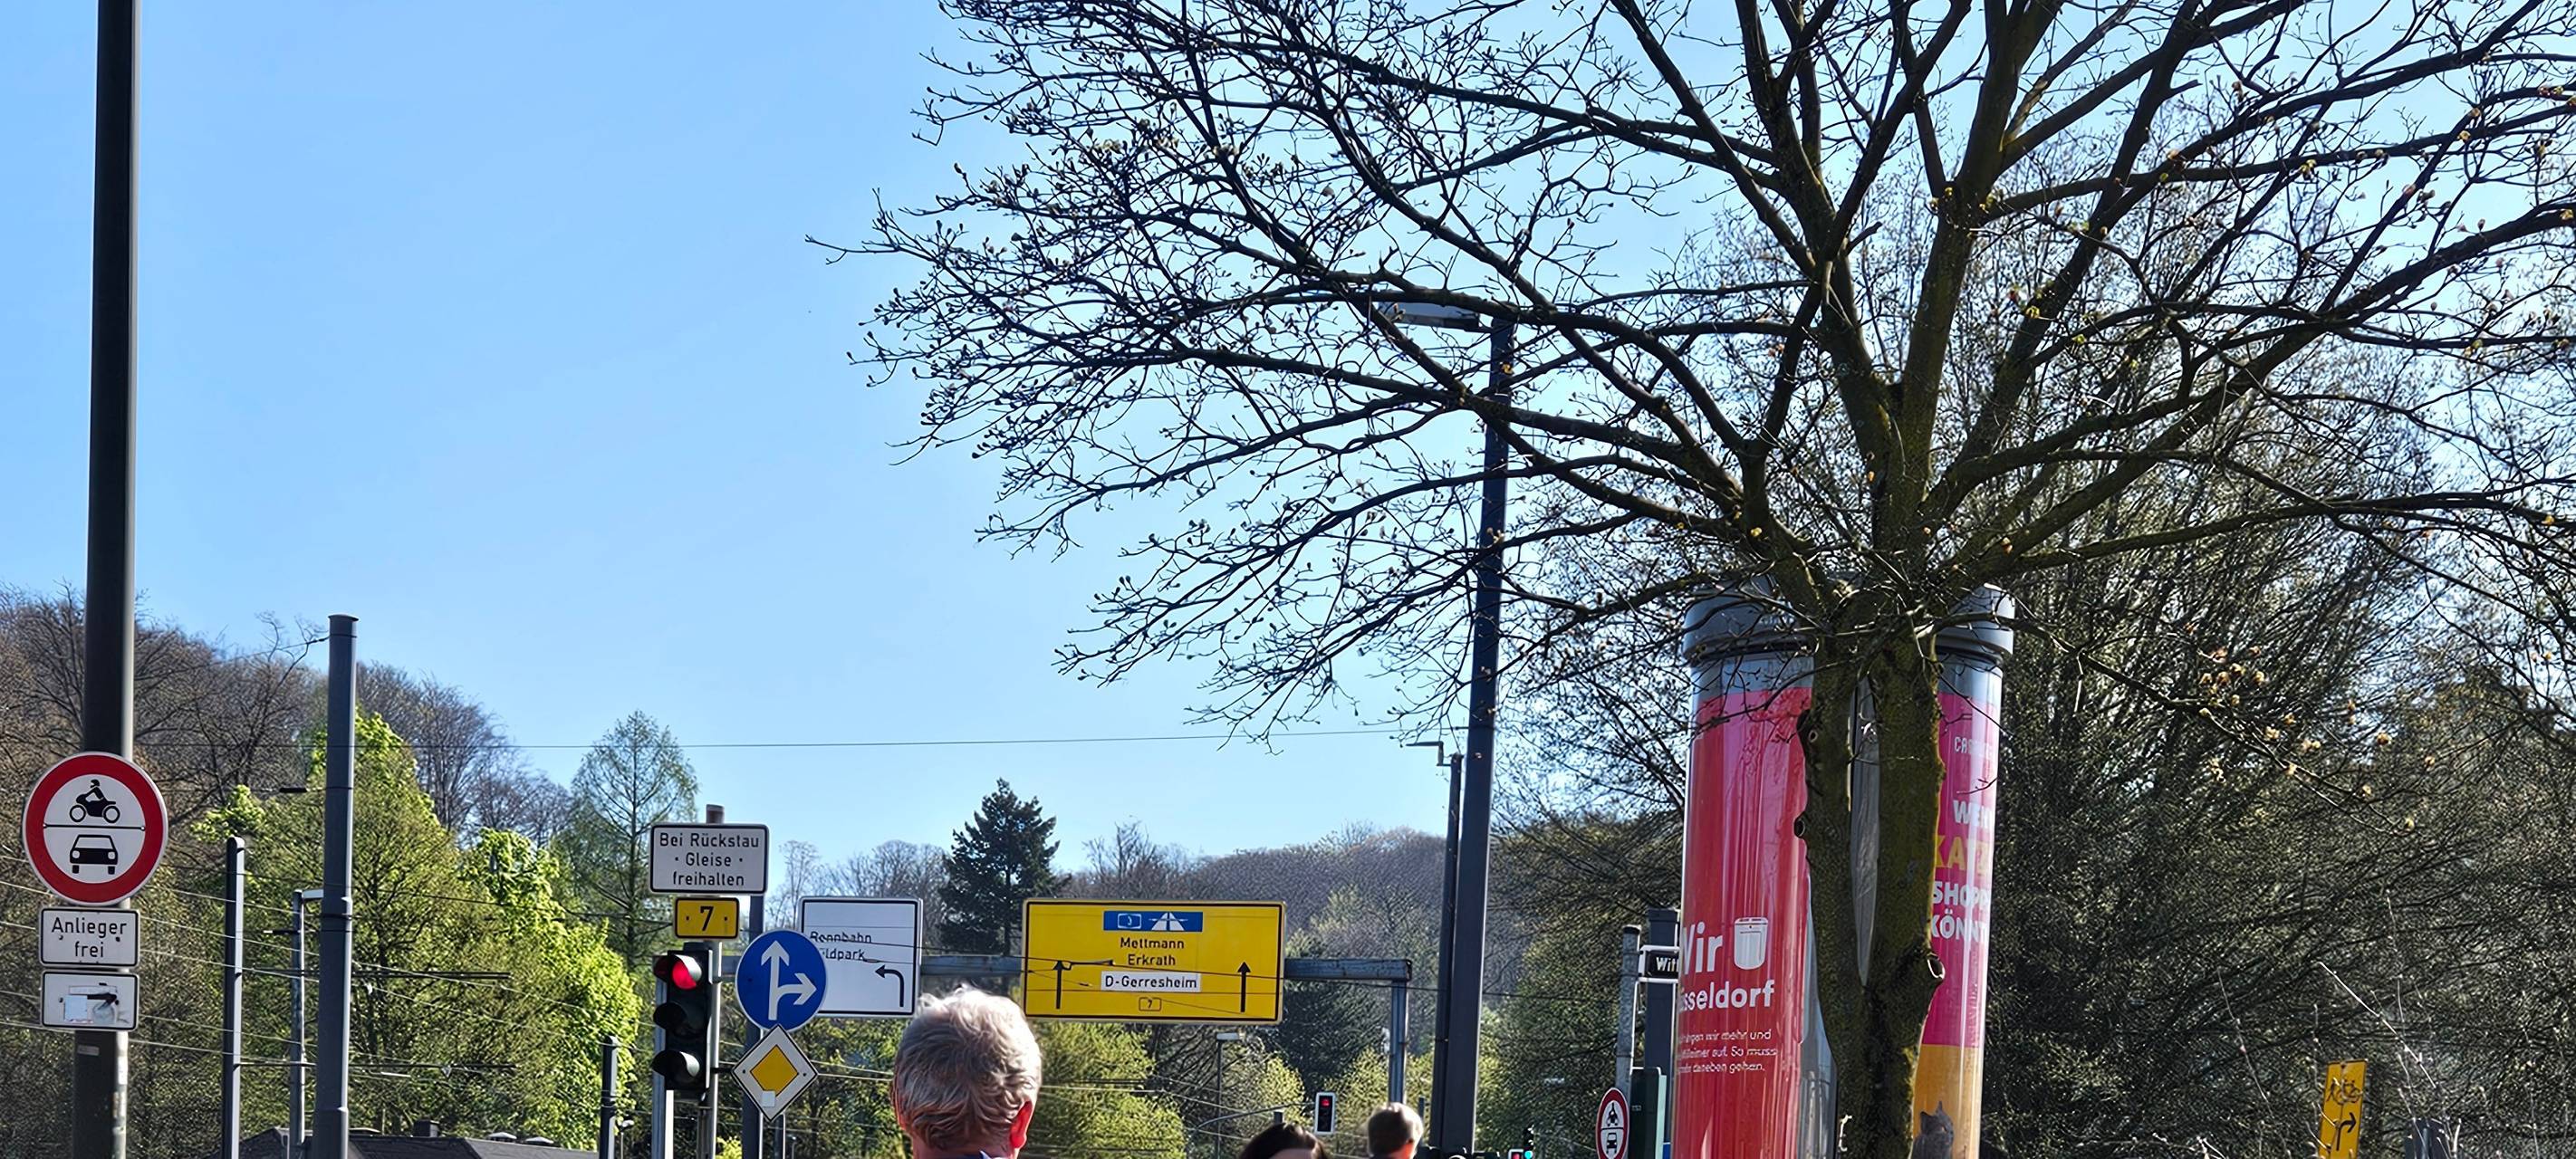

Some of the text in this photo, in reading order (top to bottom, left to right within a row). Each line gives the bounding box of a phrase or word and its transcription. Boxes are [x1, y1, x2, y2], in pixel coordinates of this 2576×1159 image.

[659, 832, 759, 848] Bei Rückstau
[686, 852, 732, 867] Gleise
[673, 871, 745, 886] freihalten
[699, 905, 715, 932] 7
[51, 916, 127, 939] Anlieger
[810, 931, 871, 943] Rennbahn
[1120, 936, 1185, 949] Mettmann
[75, 941, 104, 957] frei
[822, 947, 865, 961] ldpark
[1128, 953, 1176, 966] Erkrath
[1105, 975, 1197, 989] D-Gerresheim
[1681, 980, 1775, 1011] sseldorf
[1147, 1000, 1153, 1009] 7
[1749, 1029, 1772, 1040] und
[1731, 1046, 1745, 1057] So
